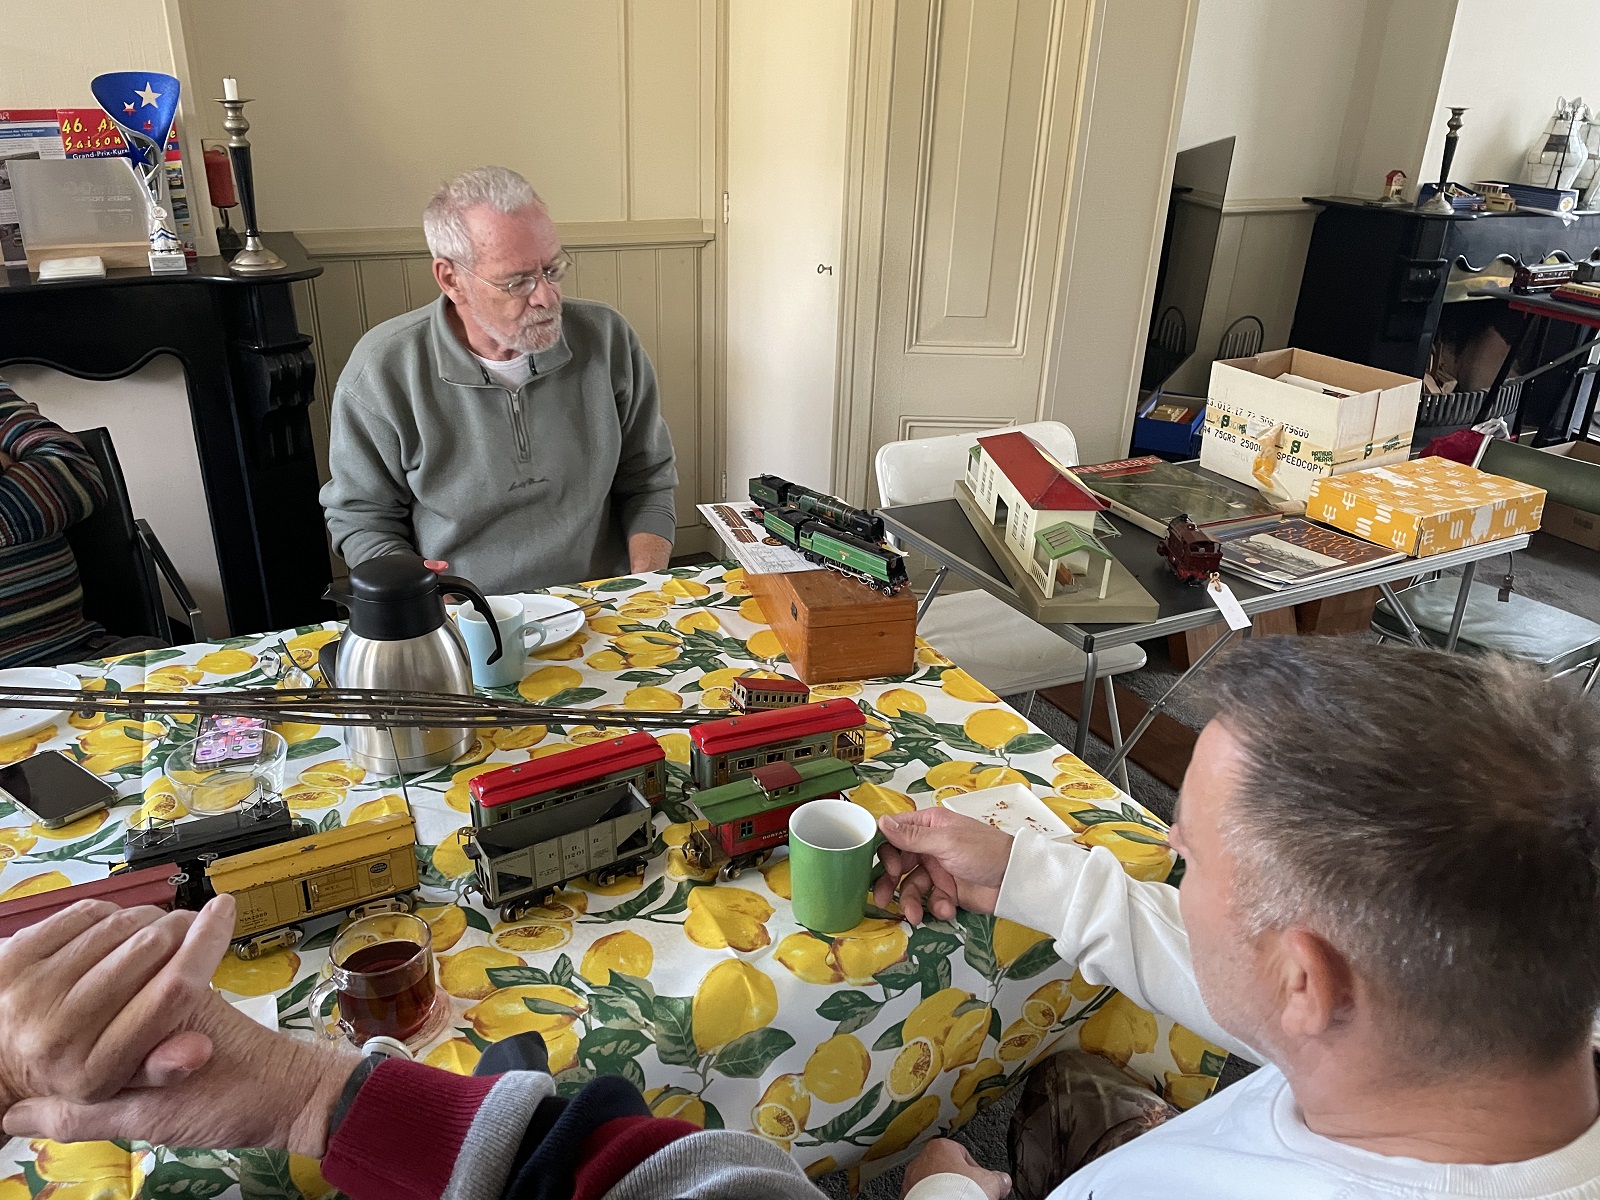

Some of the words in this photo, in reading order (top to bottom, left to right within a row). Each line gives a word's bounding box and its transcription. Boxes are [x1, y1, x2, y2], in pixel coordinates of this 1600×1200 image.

[62, 118, 88, 134] 46.
[65, 136, 121, 151] Saison
[1214, 429, 1236, 443] 75GRS
[1276, 451, 1324, 474] SPEEDCOPY
